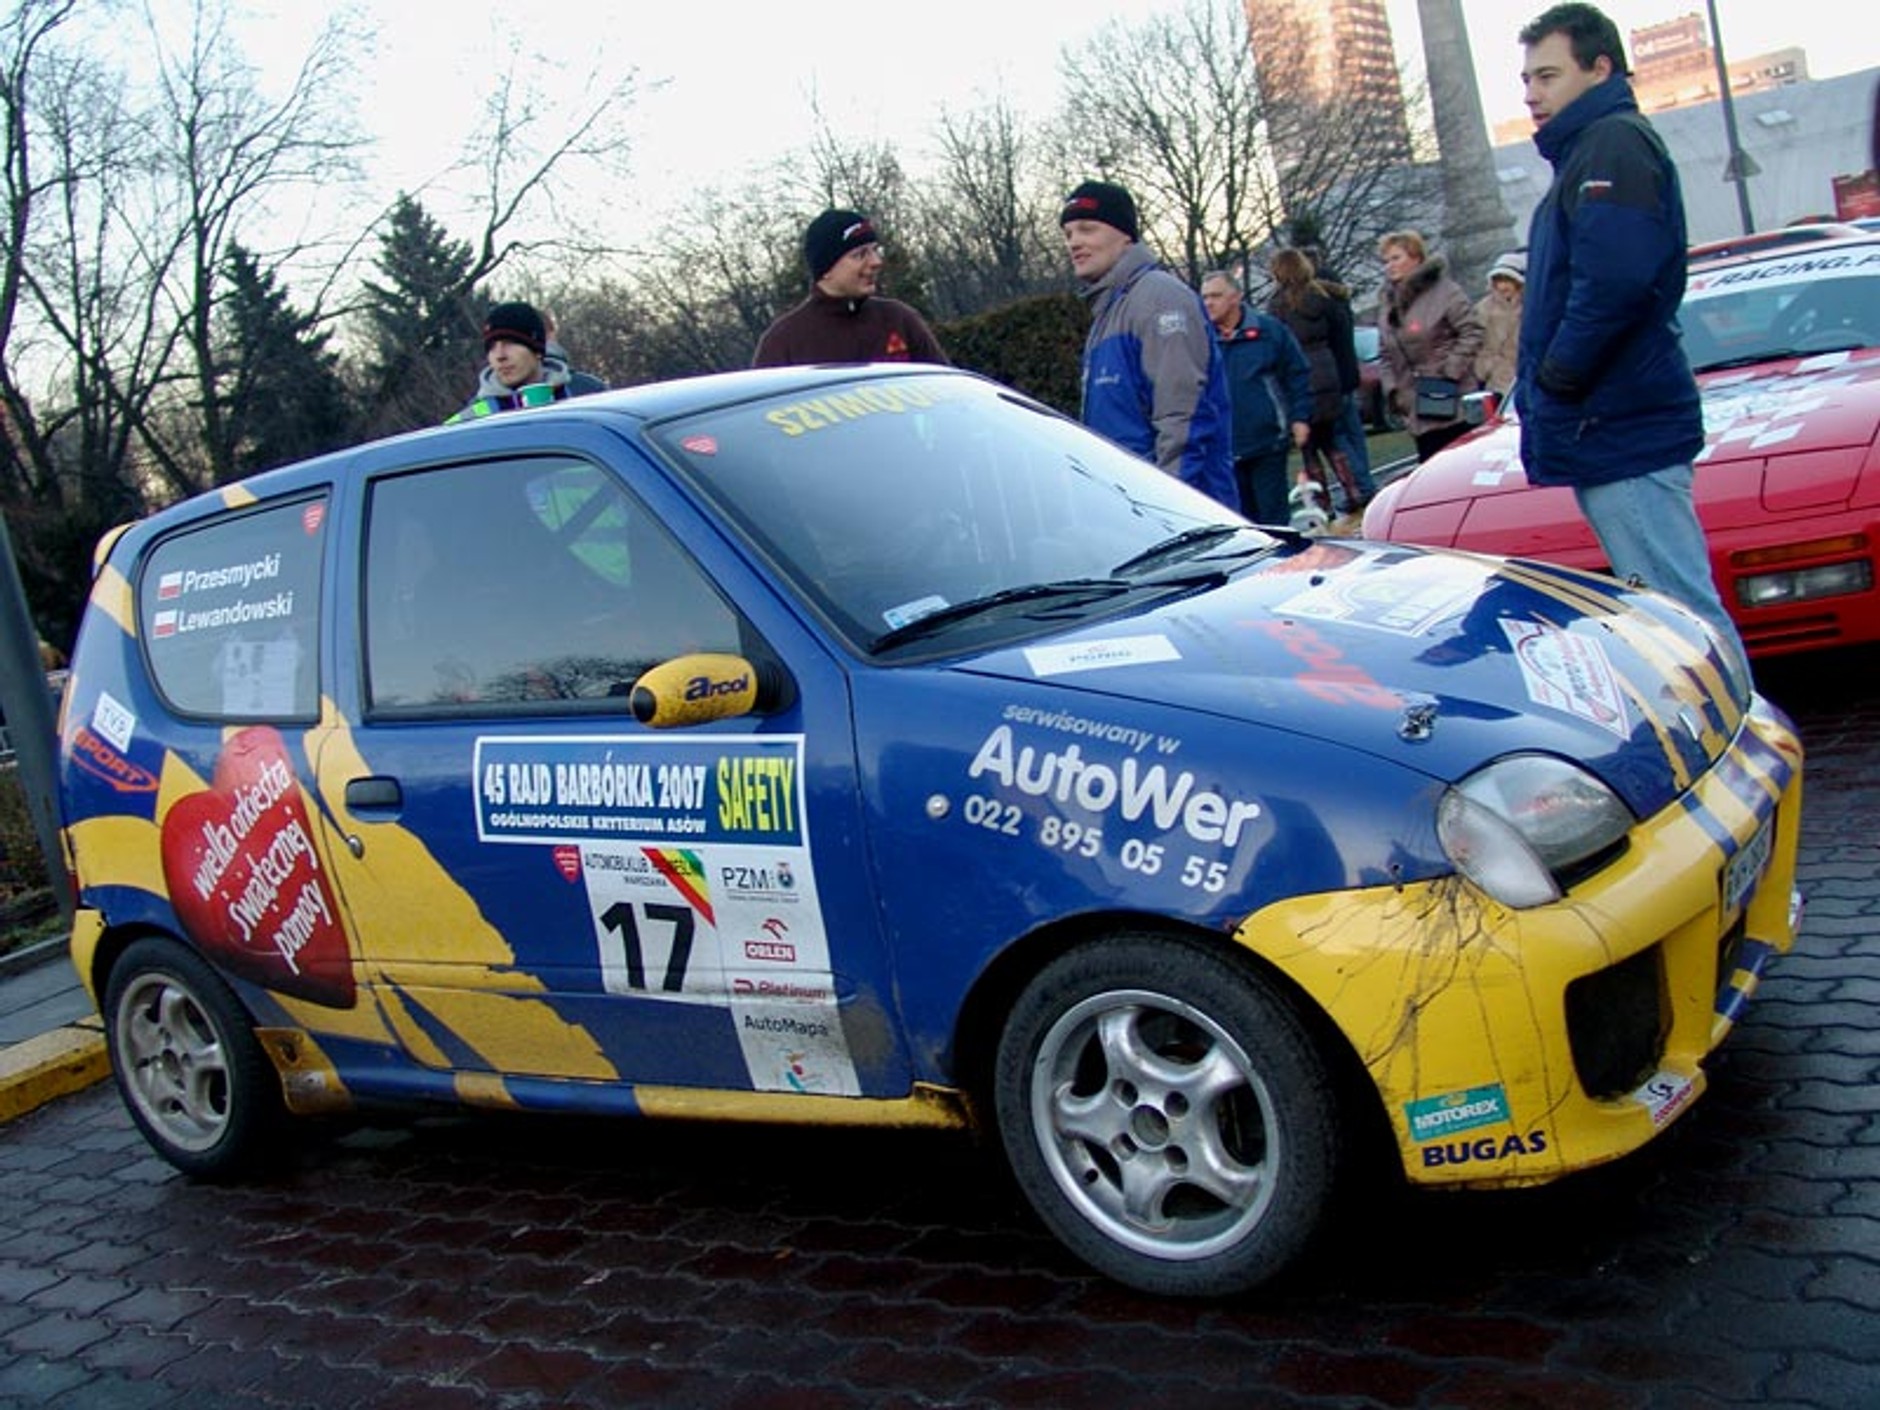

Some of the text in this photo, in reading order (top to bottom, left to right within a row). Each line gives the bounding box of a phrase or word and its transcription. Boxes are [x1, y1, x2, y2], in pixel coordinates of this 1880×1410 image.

[183, 553, 281, 593] Przesmycki
[178, 592, 293, 632] Lewandowski
[1003, 704, 1181, 754] serwisowany w
[484, 750, 793, 832] 45 RAJD BARBÓRKA 2007 SAFETY
[969, 725, 1261, 847] AutoWer
[193, 820, 238, 901] wielka
[230, 759, 290, 840] orkiestra
[964, 795, 1228, 892] 022 895 05 55
[721, 866, 770, 890] PZM
[273, 879, 333, 975] pomocy
[600, 901, 695, 993] 17
[747, 944, 794, 960] ORLEN
[744, 1015, 829, 1036] AutoMapa
[1414, 1099, 1499, 1130] MOTOREX
[1422, 1130, 1547, 1167] BUGAS
